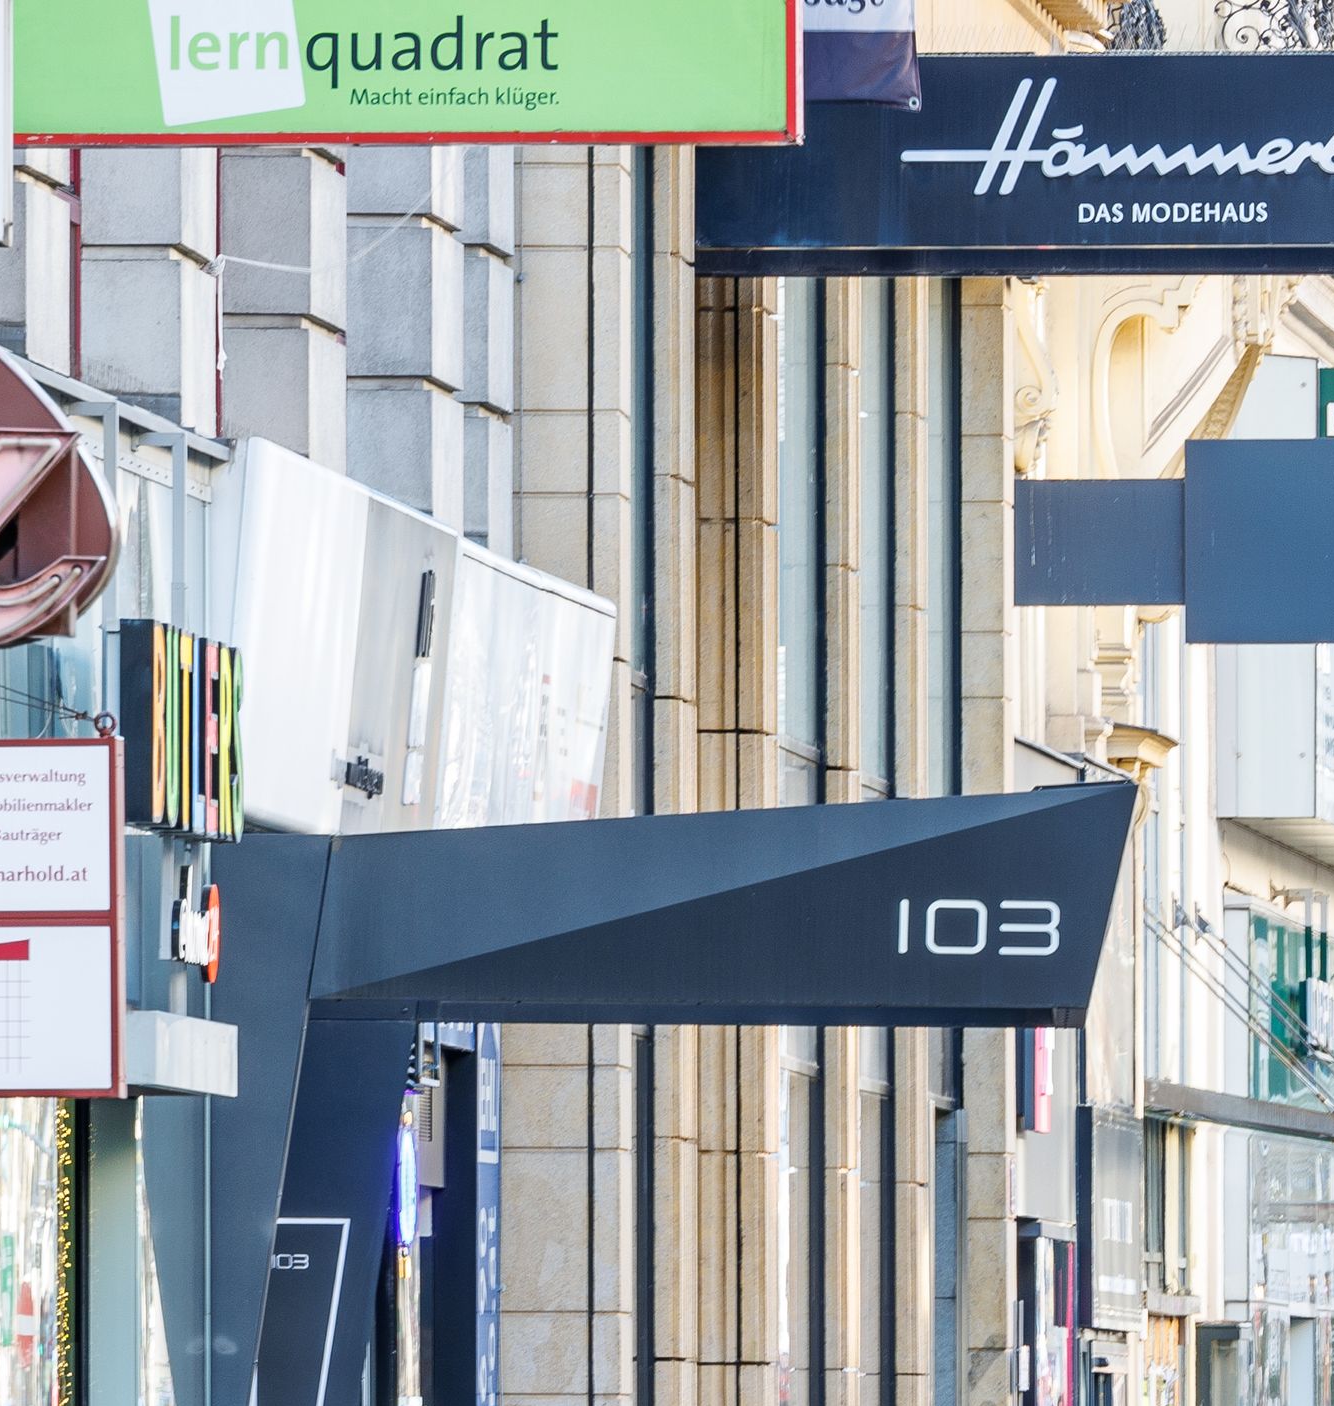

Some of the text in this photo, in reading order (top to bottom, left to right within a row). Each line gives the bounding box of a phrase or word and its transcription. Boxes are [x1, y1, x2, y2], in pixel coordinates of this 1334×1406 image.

[350, 84, 559, 112] Macht einfach klüger.
[1077, 201, 1269, 225] DAS MODEHAUS
[152, 622, 244, 844] BUTLERS
[897, 897, 1062, 957] 103
[270, 1253, 310, 1271] 103
